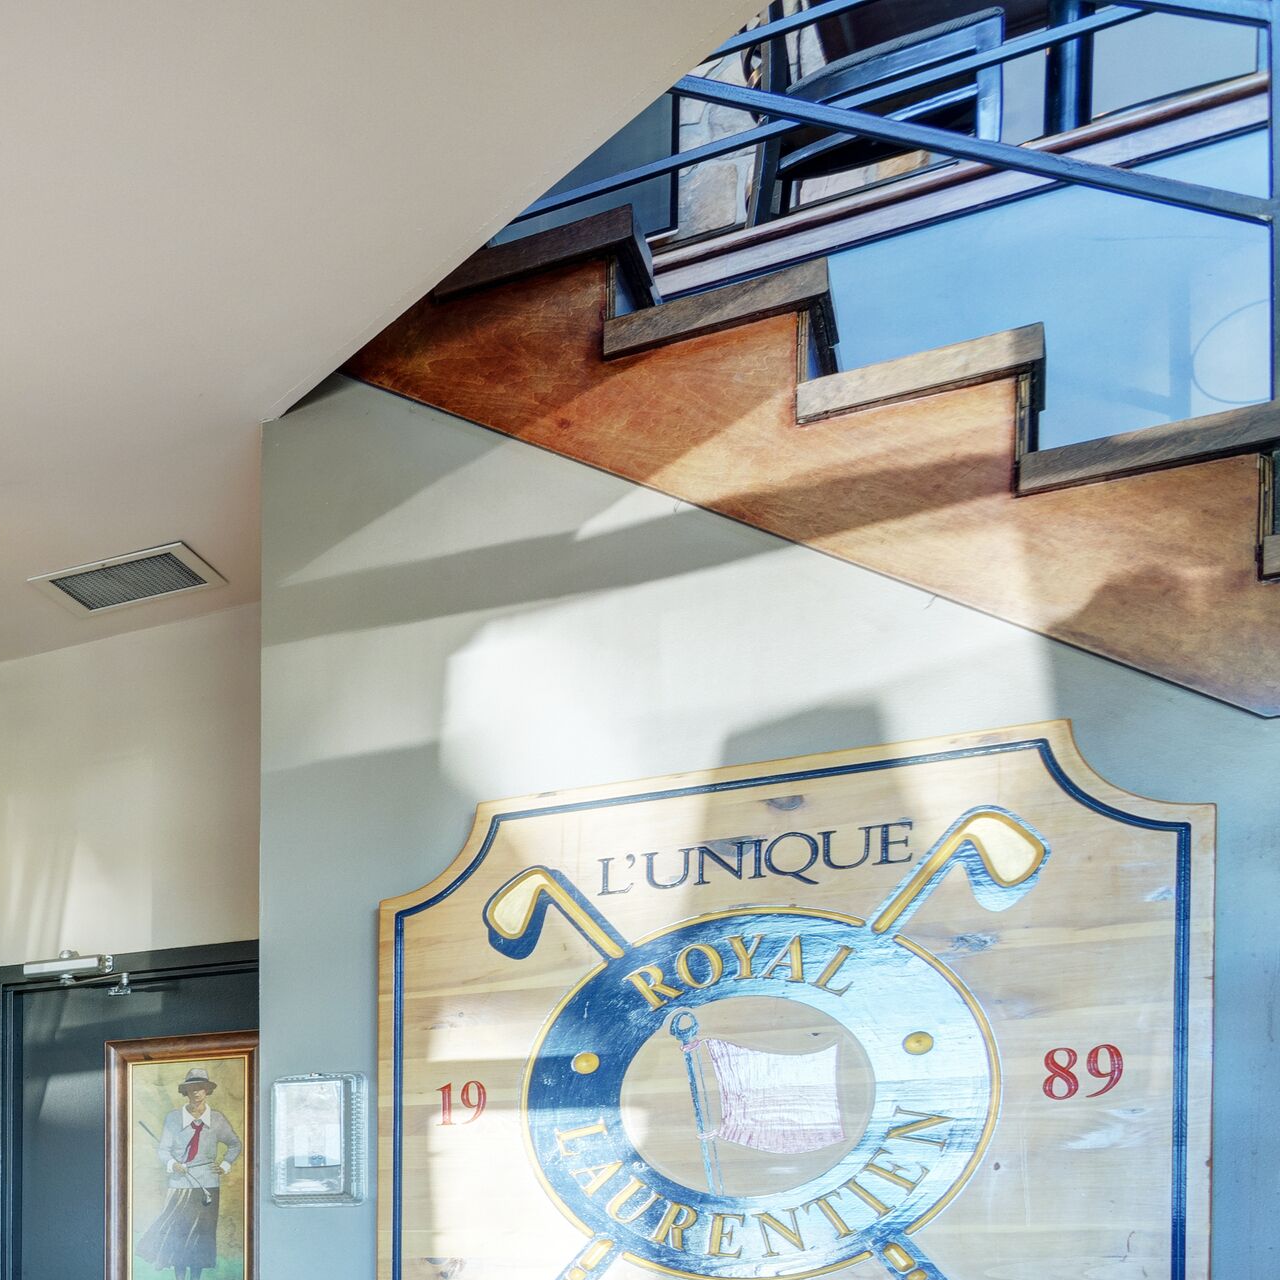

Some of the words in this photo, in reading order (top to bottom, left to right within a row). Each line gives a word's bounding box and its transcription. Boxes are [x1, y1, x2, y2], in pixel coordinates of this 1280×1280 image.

[597, 820, 914, 896] L'UNIQUE
[622, 933, 857, 1011] ROYAL
[436, 1080, 487, 1127] 19
[1043, 1043, 1124, 1102] 89
[555, 1106, 955, 1258] LAURENTIEN
